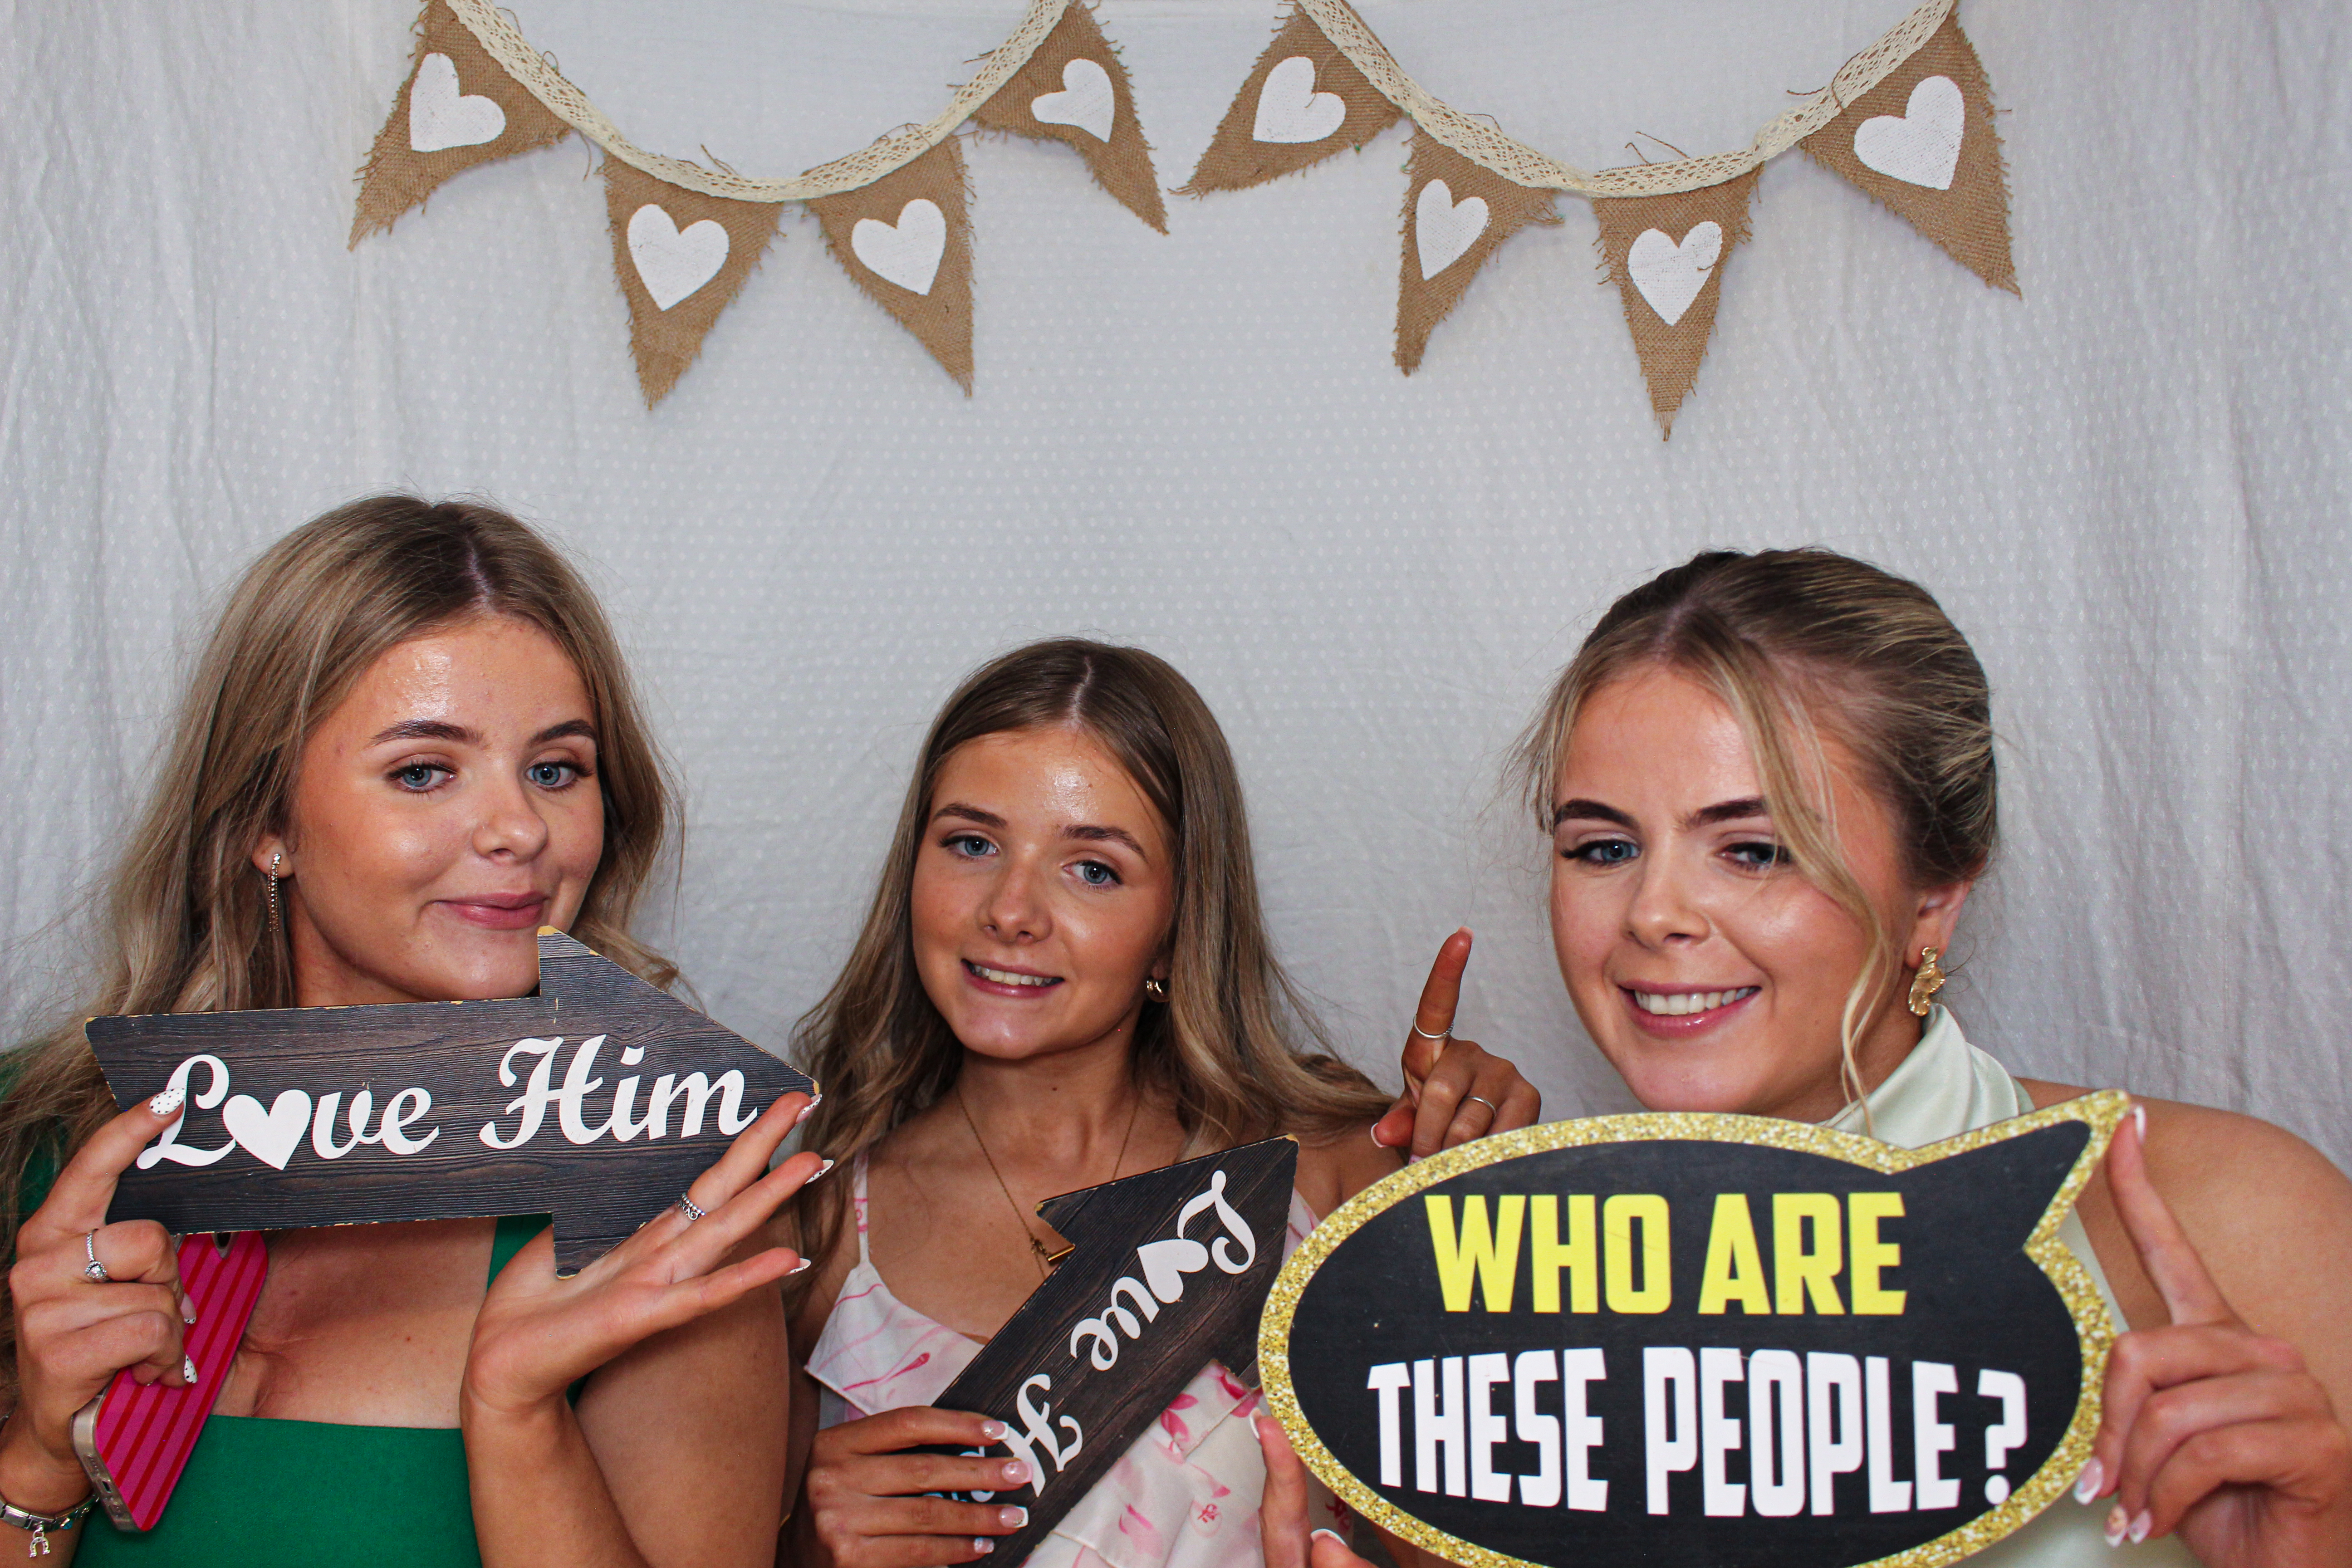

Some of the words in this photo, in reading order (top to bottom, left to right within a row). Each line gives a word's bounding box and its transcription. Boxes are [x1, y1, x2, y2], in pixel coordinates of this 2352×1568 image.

[478, 1034, 758, 1150] Him
[1425, 1194, 1672, 1314] WHO
[1698, 1192, 1907, 1315] ARE
[1366, 1348, 1609, 1512] THESE
